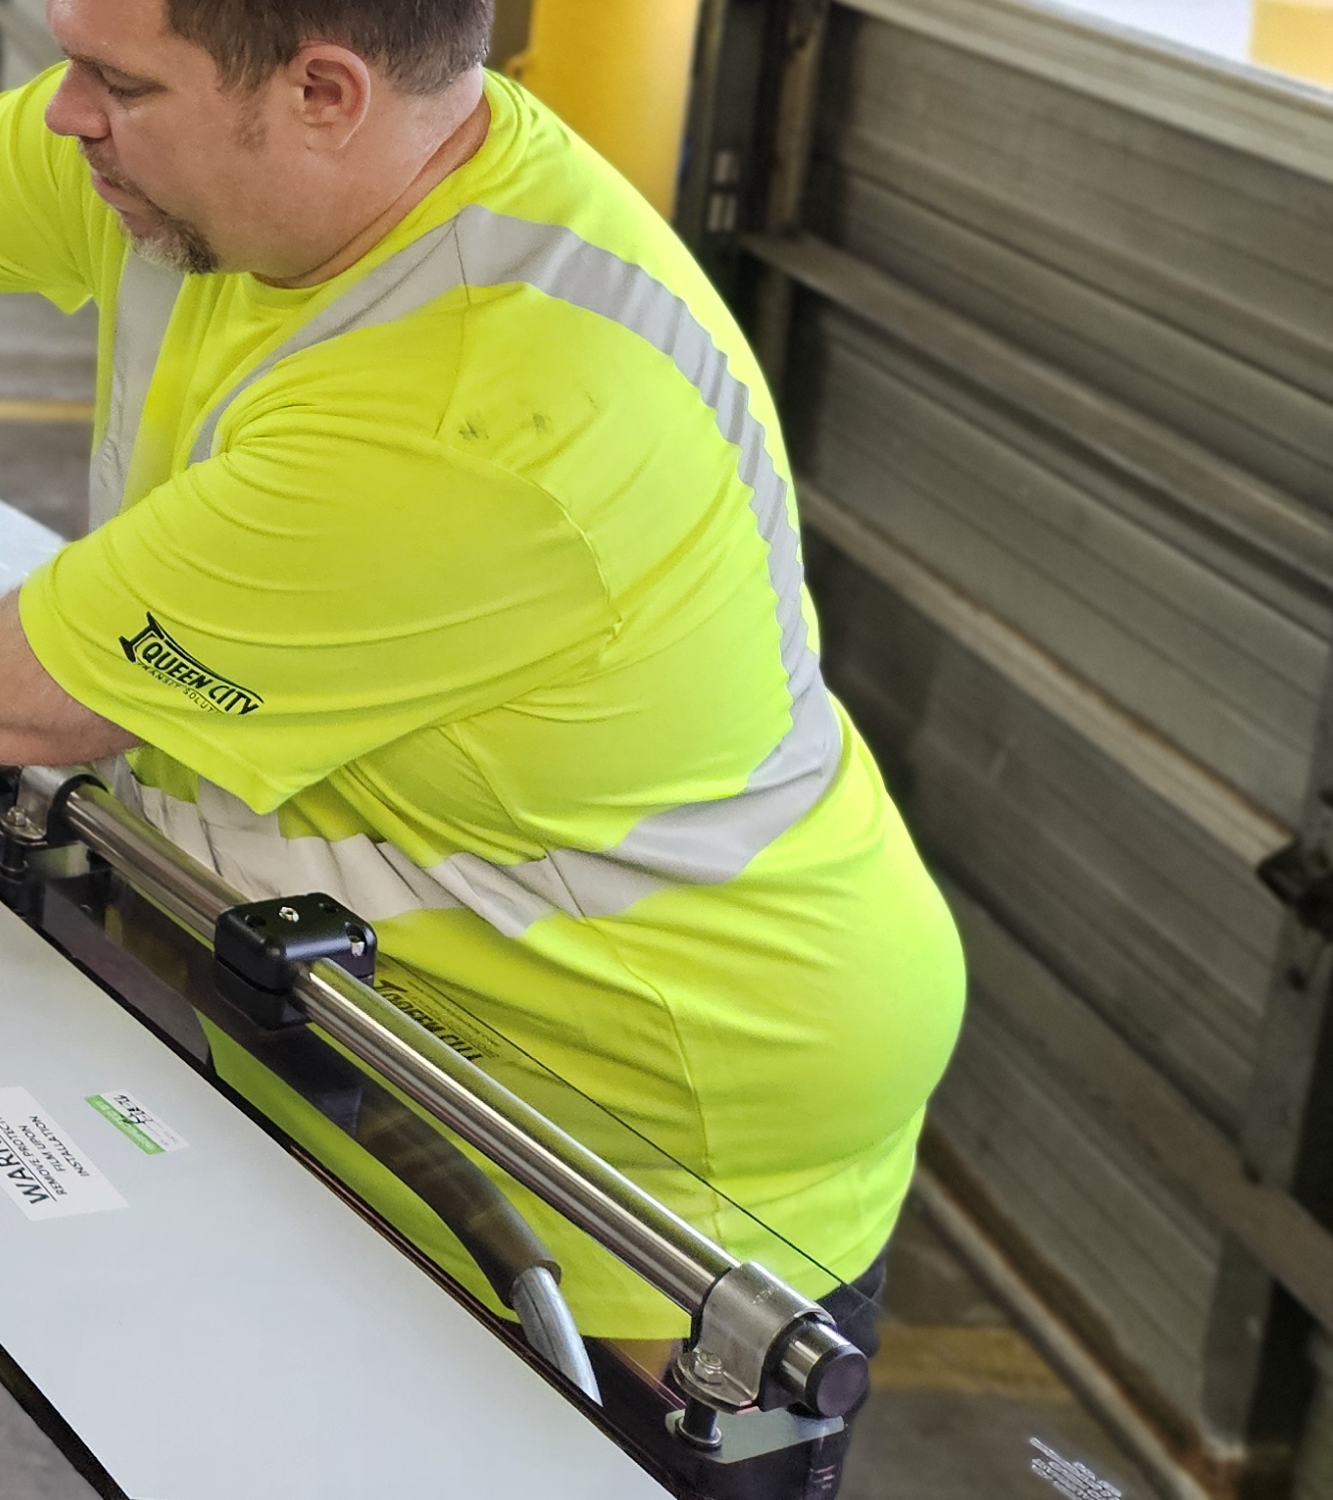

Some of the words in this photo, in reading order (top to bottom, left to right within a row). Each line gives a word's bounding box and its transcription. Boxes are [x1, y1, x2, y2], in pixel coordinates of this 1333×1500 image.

[142, 641, 213, 689] QUEEN
[208, 684, 259, 715] CITY
[17, 1123, 46, 1149] UPON
[28, 1115, 89, 1176] INSTALLATION
[29, 1158, 67, 1195] REMOVE
[40, 1150, 66, 1171] FILM
